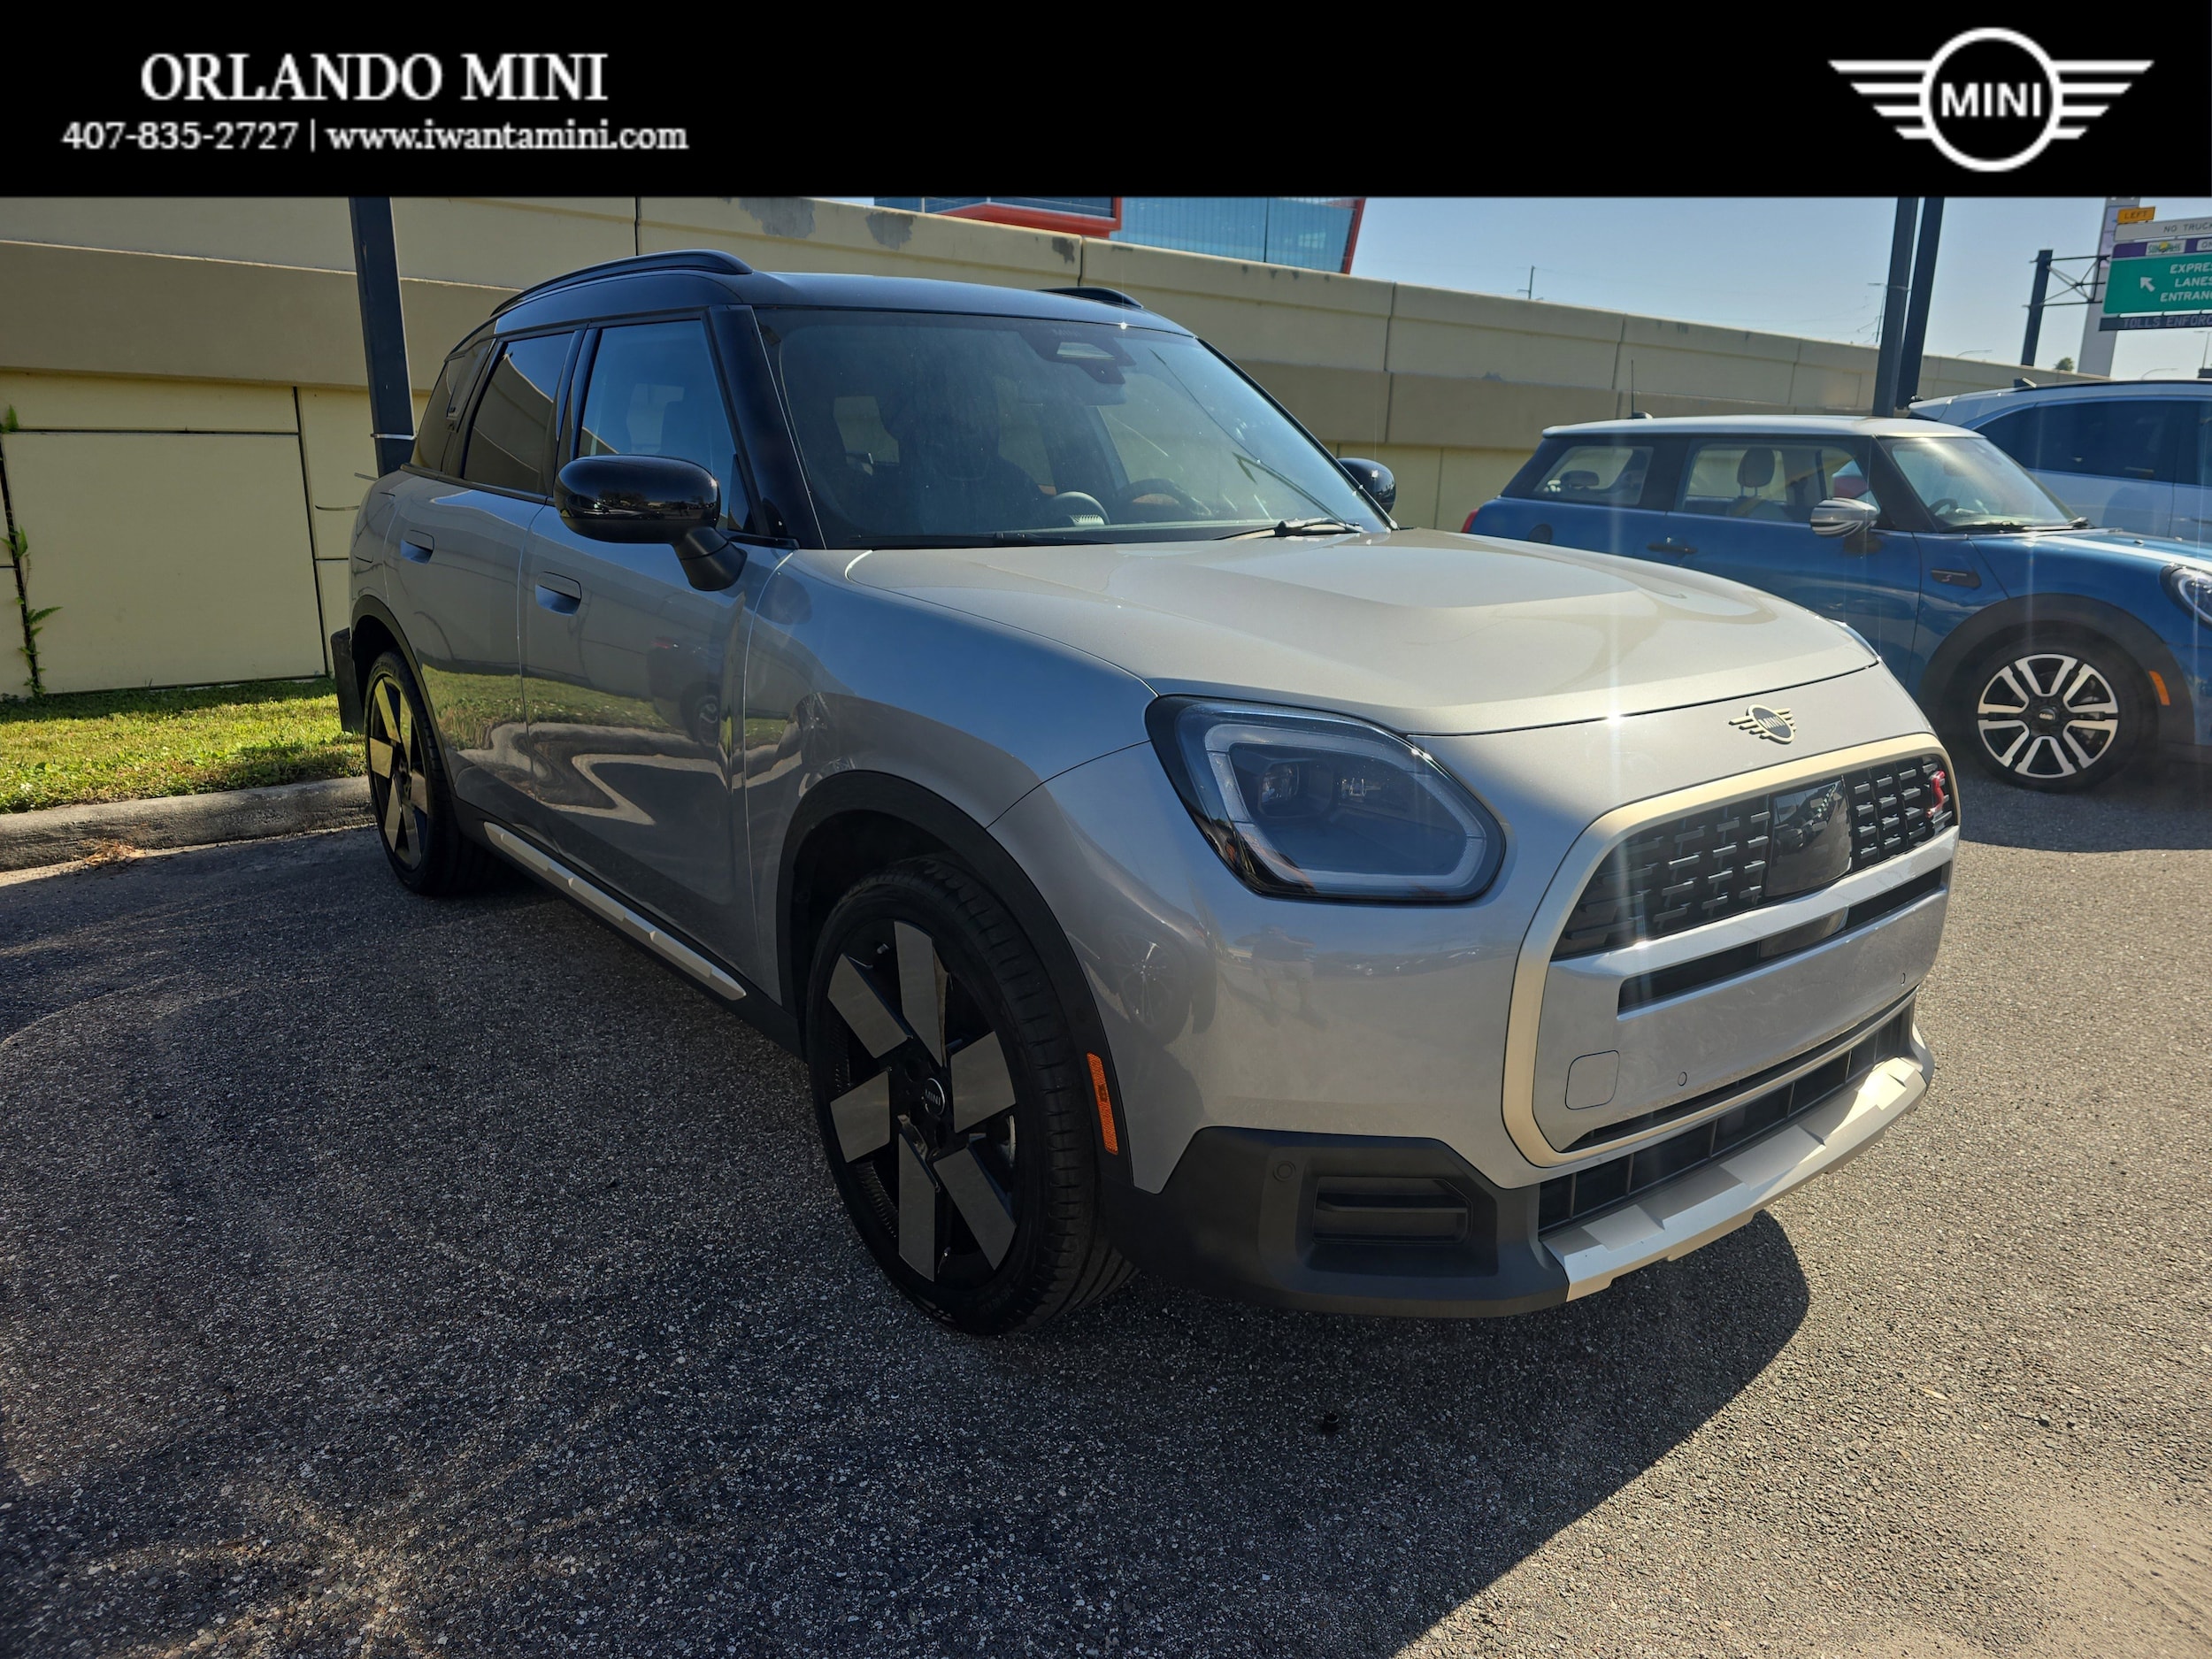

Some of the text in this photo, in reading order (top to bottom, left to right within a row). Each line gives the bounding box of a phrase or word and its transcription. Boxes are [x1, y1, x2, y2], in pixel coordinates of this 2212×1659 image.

[2124, 210, 2147, 219] LEFT
[2163, 224, 2177, 233] NO
[2170, 262, 2212, 274] EXPRE
[2124, 317, 2160, 328] TOLLS
[1757, 715, 1786, 729] MINI
